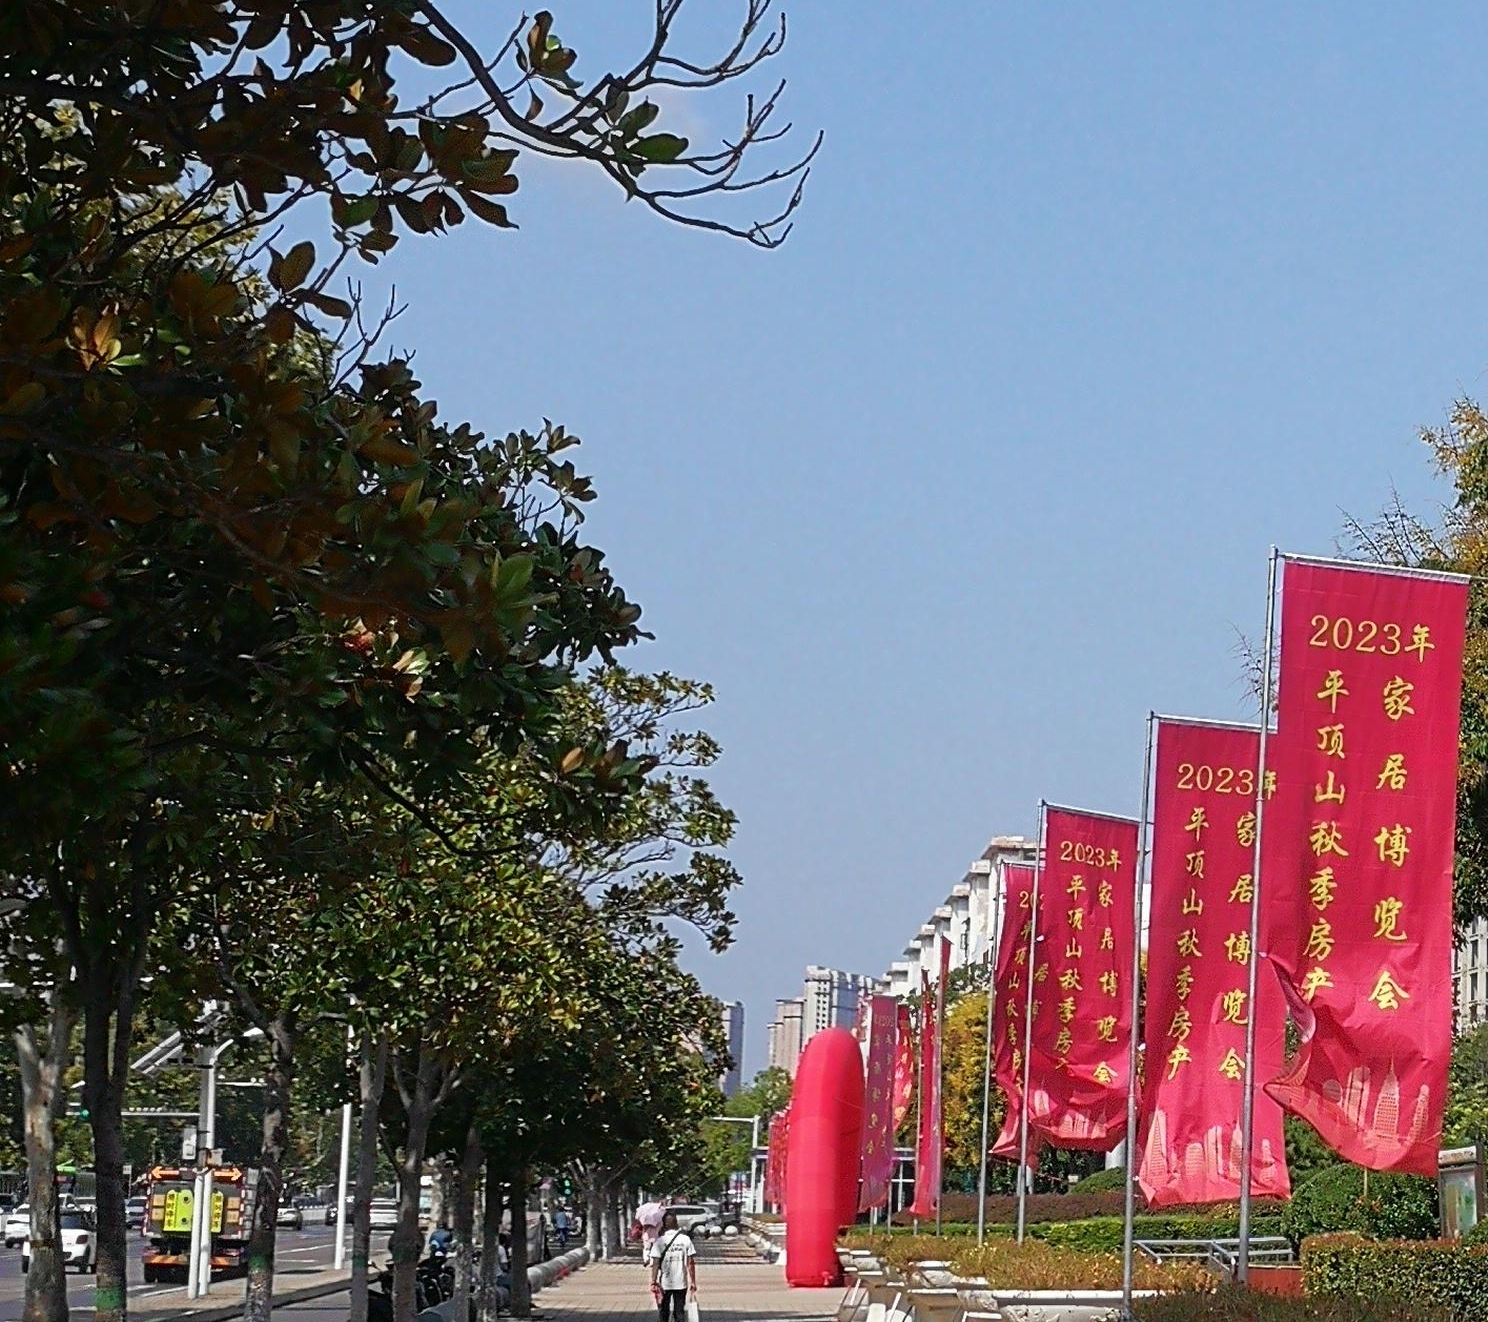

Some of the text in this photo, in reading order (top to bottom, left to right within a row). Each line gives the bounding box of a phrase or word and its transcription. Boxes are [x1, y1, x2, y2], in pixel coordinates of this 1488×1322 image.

[1308, 614, 1436, 663] 2023年
[1059, 840, 1122, 873] 2023年
[1176, 763, 1277, 801] 2023年
[1300, 669, 1350, 1004] 平顶山秋季房产
[1367, 675, 1417, 1012] 家居博览会
[1166, 806, 1212, 1082] 平顶山秋季房产
